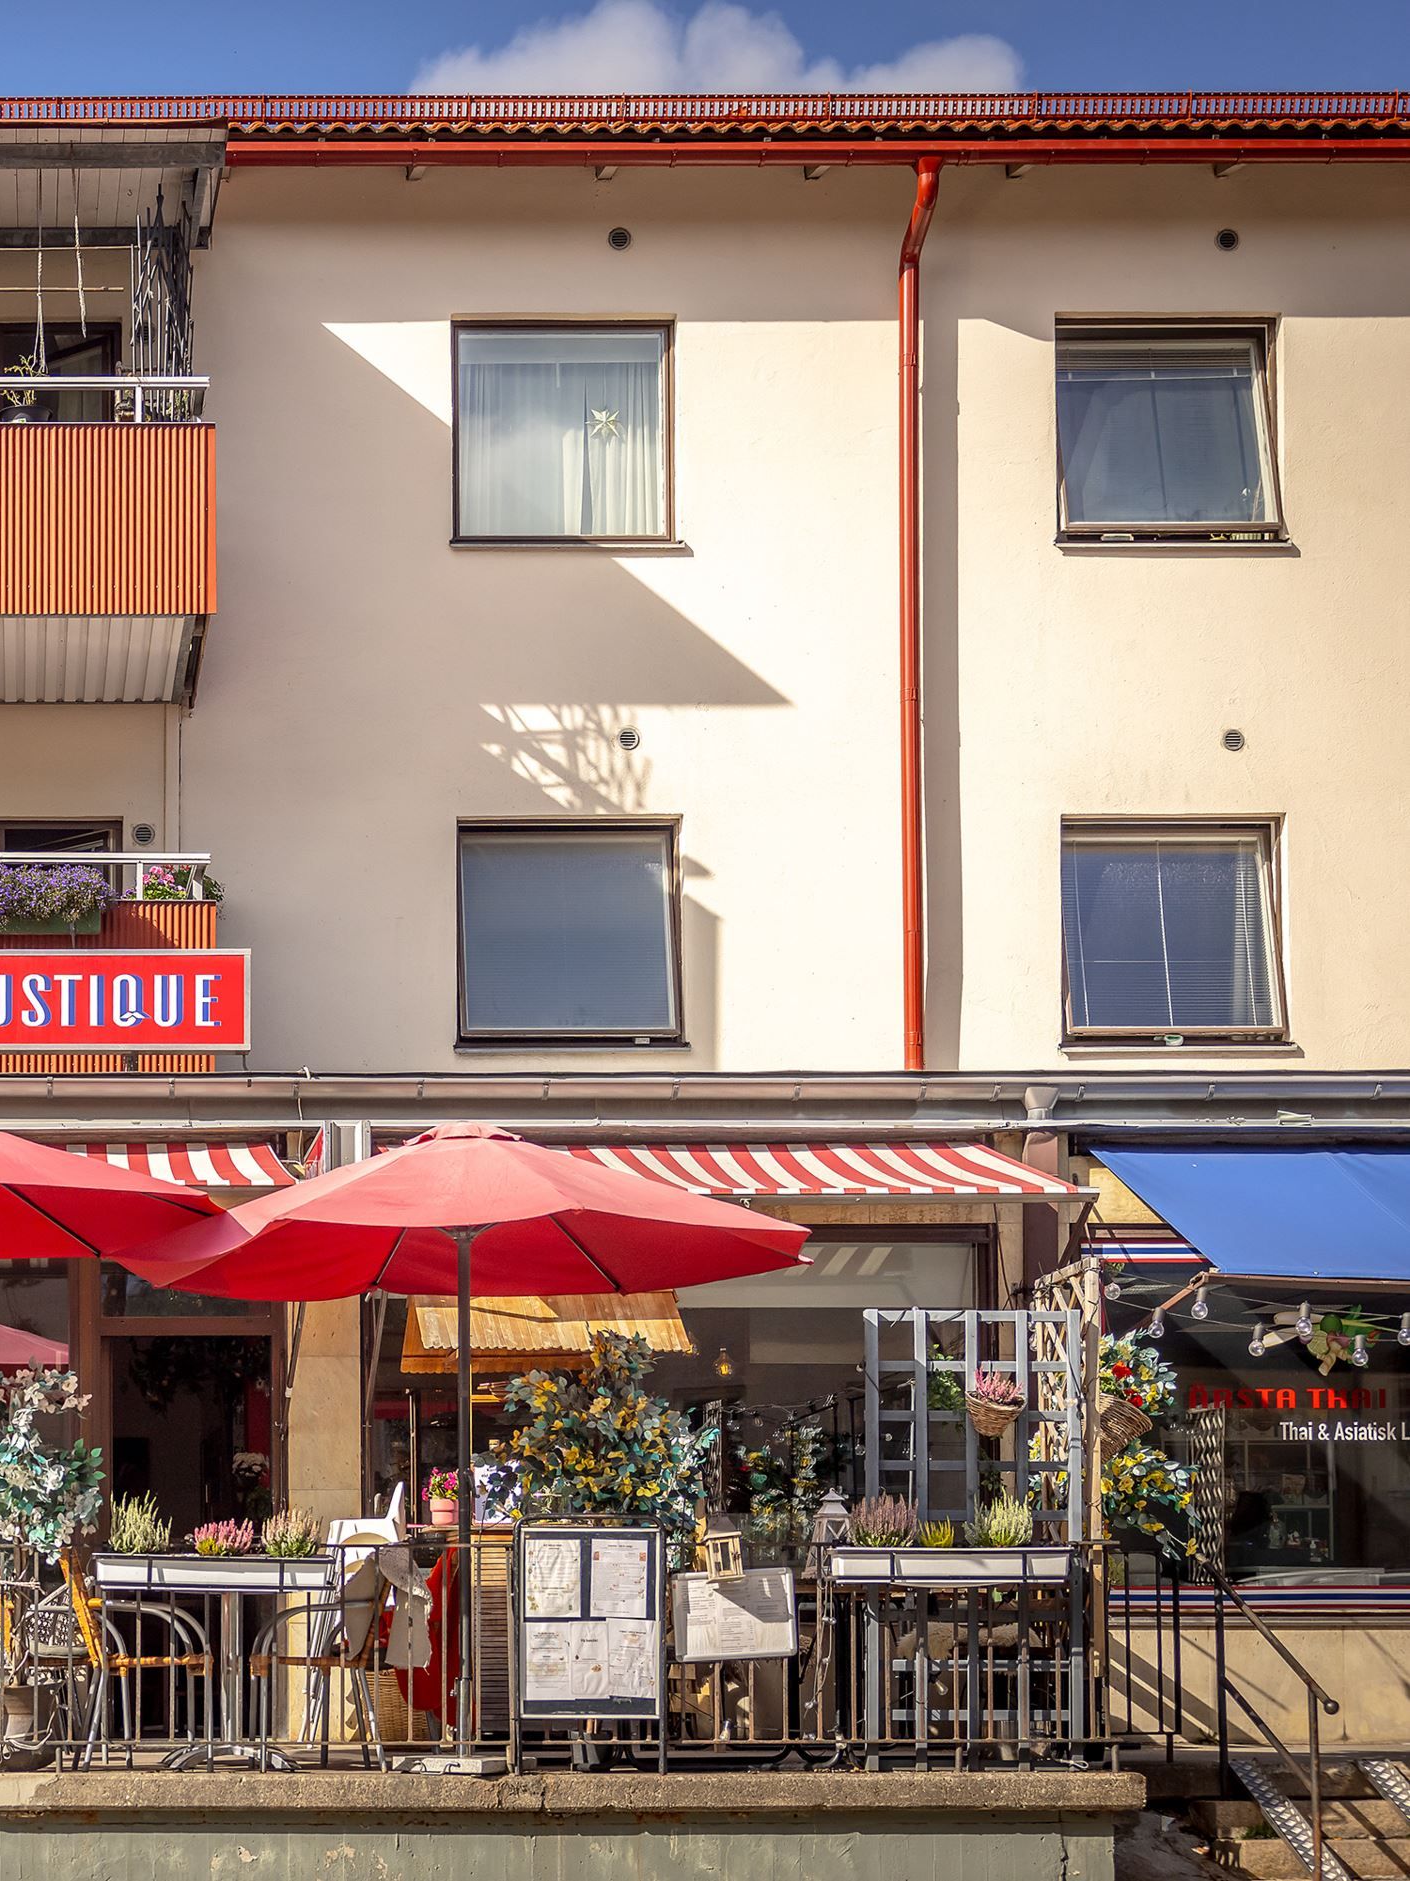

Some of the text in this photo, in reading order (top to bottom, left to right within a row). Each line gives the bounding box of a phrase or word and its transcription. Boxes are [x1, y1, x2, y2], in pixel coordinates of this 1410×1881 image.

[1306, 1387, 1386, 1409] THAI
[1279, 1421, 1313, 1441] Thai
[1318, 1423, 1330, 1441] &
[1333, 1421, 1397, 1441] Asiatisk
